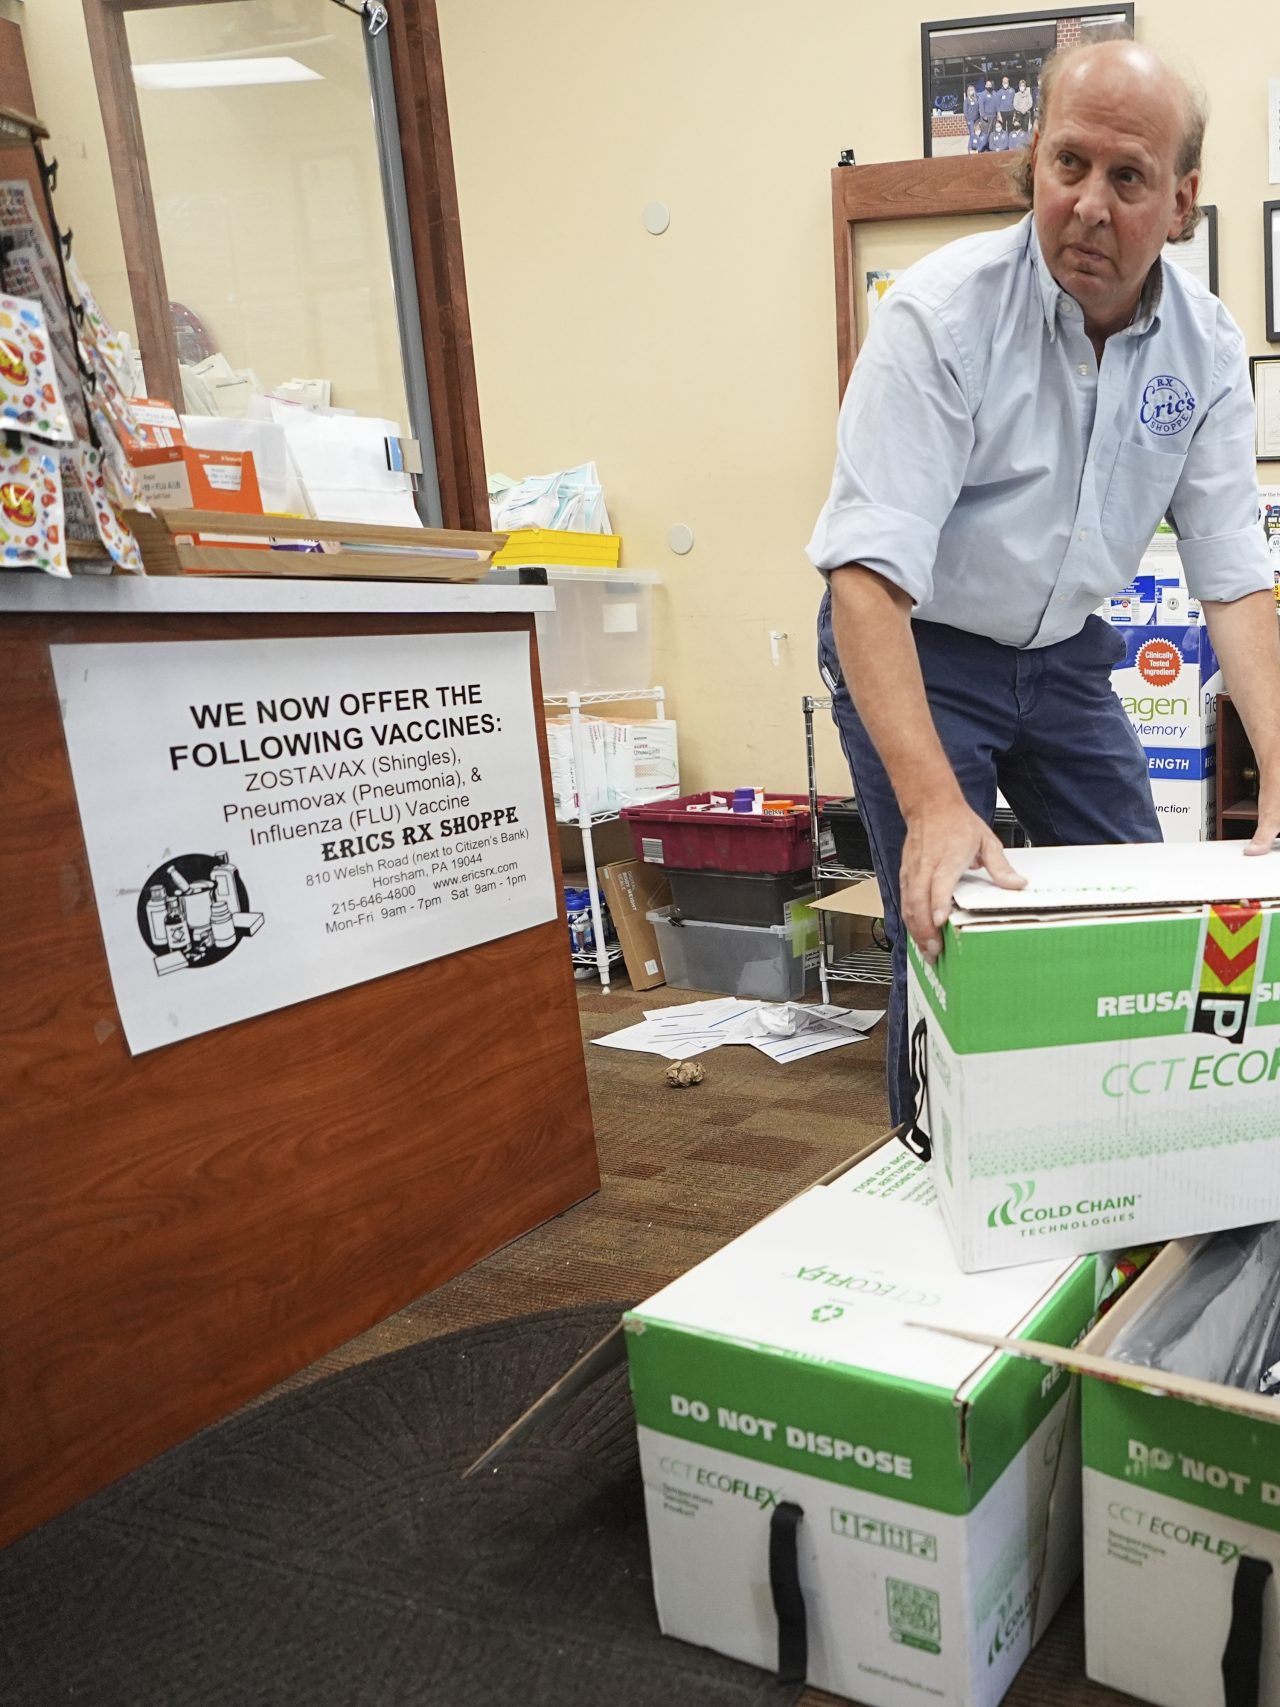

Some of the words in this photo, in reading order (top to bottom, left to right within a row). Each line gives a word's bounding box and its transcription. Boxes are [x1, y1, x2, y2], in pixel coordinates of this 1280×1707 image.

[1140, 386, 1195, 423] Eric's
[1150, 414, 1188, 432] SHOPPE
[1144, 668, 1176, 676] Ingredient
[1145, 651, 1174, 661] Clinically
[1150, 659, 1169, 667] Tested
[191, 703, 247, 729] WE
[257, 696, 330, 723] NOW
[340, 688, 430, 716] OFFER
[436, 684, 482, 706] THE
[1123, 697, 1187, 720] agen
[169, 727, 364, 771] FOLLOWING
[371, 714, 502, 747] VACCINES:
[1149, 758, 1189, 770] ENGTH
[245, 758, 366, 792] ZOSTAVAX
[372, 747, 461, 777] (Shingles),
[223, 791, 347, 822] Pneumovax
[352, 769, 466, 804] (Pneumonia),
[471, 767, 482, 783] &
[250, 818, 343, 846] Influenza
[350, 804, 401, 831] (FLU)
[407, 793, 470, 817] Vaccine
[320, 831, 395, 862] ERICS
[402, 823, 435, 846] RX
[440, 807, 519, 837] SHOPPE
[306, 871, 331, 886] 810
[334, 864, 374, 880] Welsh
[377, 854, 409, 871] Road
[412, 849, 439, 866] (next
[442, 846, 453, 856] to
[456, 836, 498, 853] Citizen's
[501, 829, 529, 843] Bank)
[372, 868, 429, 888] Horsham,
[432, 862, 448, 874] PA
[451, 853, 483, 869] 19044
[326, 913, 374, 934] Mon-Fri
[381, 905, 407, 919] 9am
[418, 896, 442, 912] 7pm
[450, 888, 469, 901] Sat
[474, 880, 497, 895] 9am
[506, 874, 527, 888] 1pm
[332, 885, 416, 915] 215-646-4800
[433, 860, 518, 890] www.ericsrx.com
[1097, 989, 1195, 1017] REUSA
[1103, 1057, 1184, 1098] CCT
[1020, 1203, 1074, 1222] COLD
[1076, 1195, 1136, 1218] CHAIN
[1020, 1212, 1135, 1236] TECHNOLOGIES
[671, 1394, 709, 1422] DO
[718, 1407, 776, 1441] NOT
[786, 1426, 912, 1479] DISPOSE
[660, 1456, 694, 1480] CCT
[697, 1468, 783, 1510] ECOFLEX
[1128, 1439, 1172, 1471] DO
[1179, 1456, 1251, 1496] NOT
[1108, 1502, 1147, 1527] CCT
[1150, 1510, 1248, 1564] ECOFLEX
